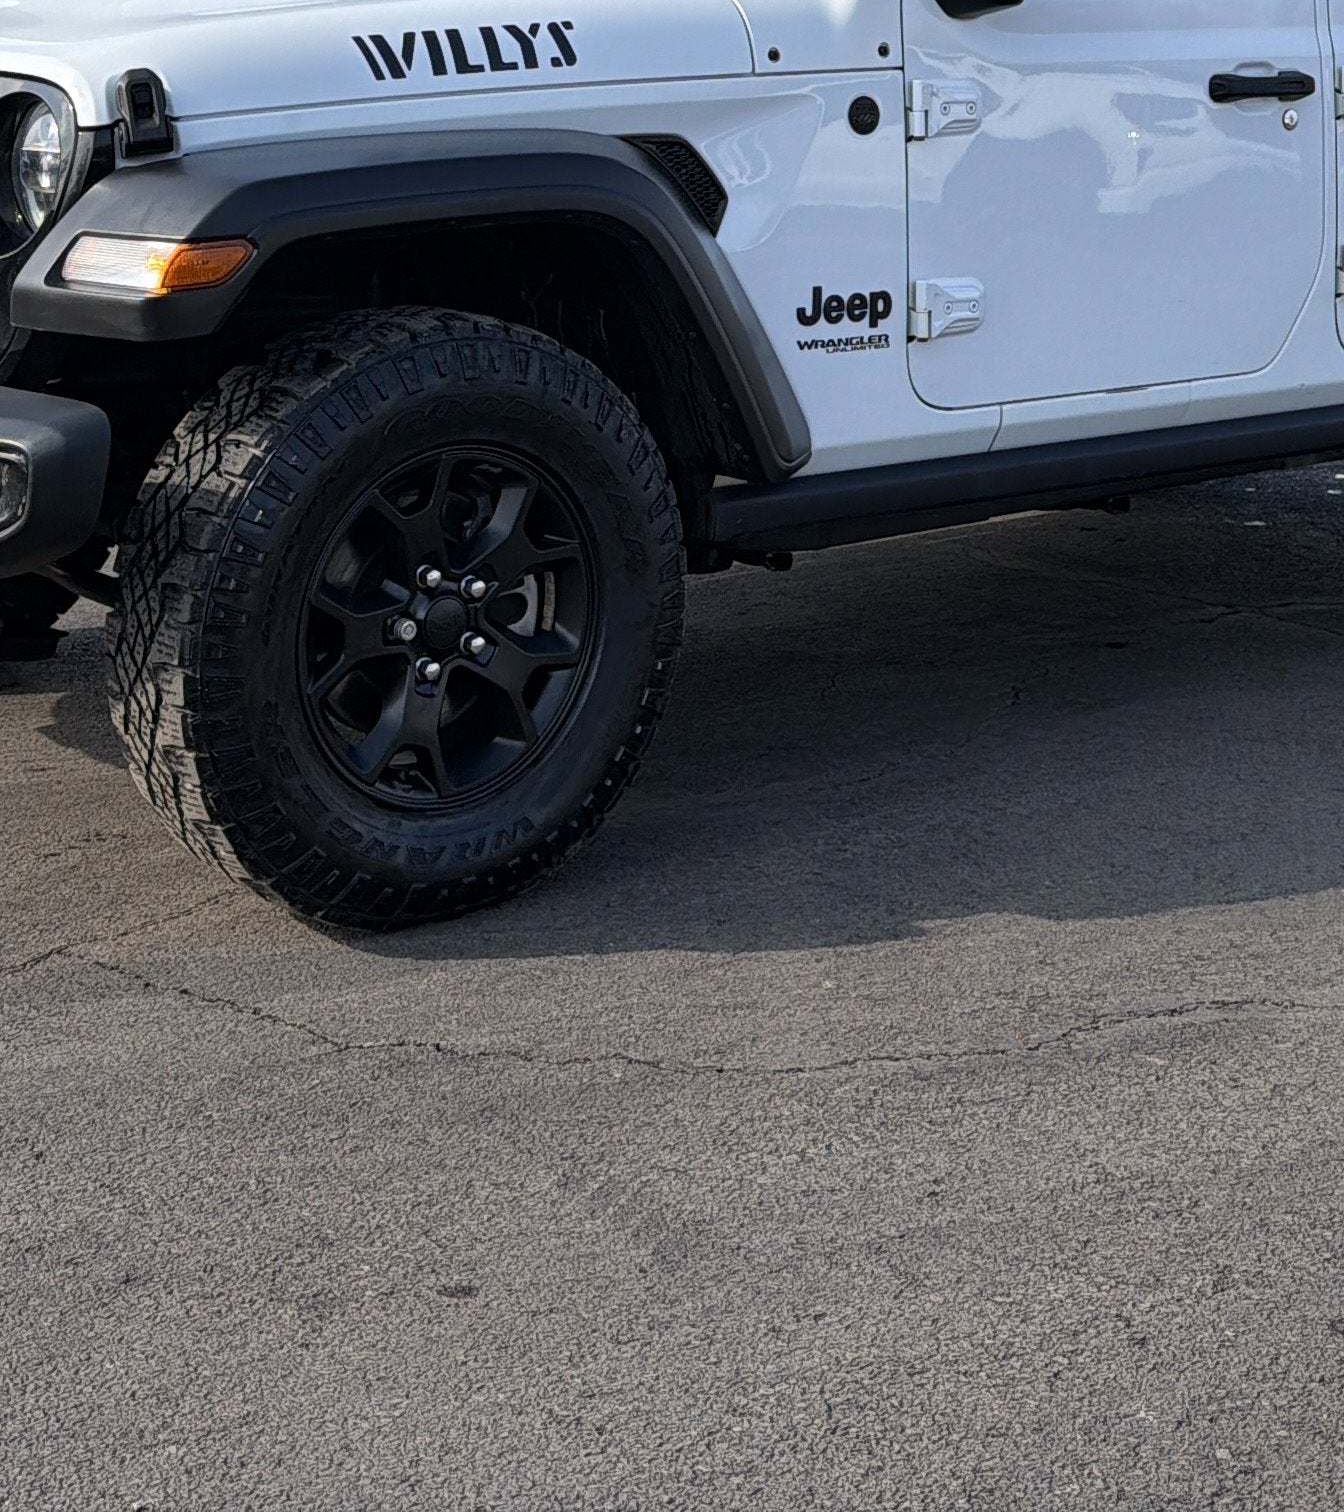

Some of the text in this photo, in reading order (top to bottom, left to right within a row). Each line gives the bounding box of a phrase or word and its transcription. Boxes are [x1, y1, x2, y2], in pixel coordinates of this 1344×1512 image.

[351, 20, 577, 81] WILLYS
[796, 285, 892, 328] Jeep
[796, 333, 889, 351] WRANGLER
[826, 343, 889, 354] UNLIMITED
